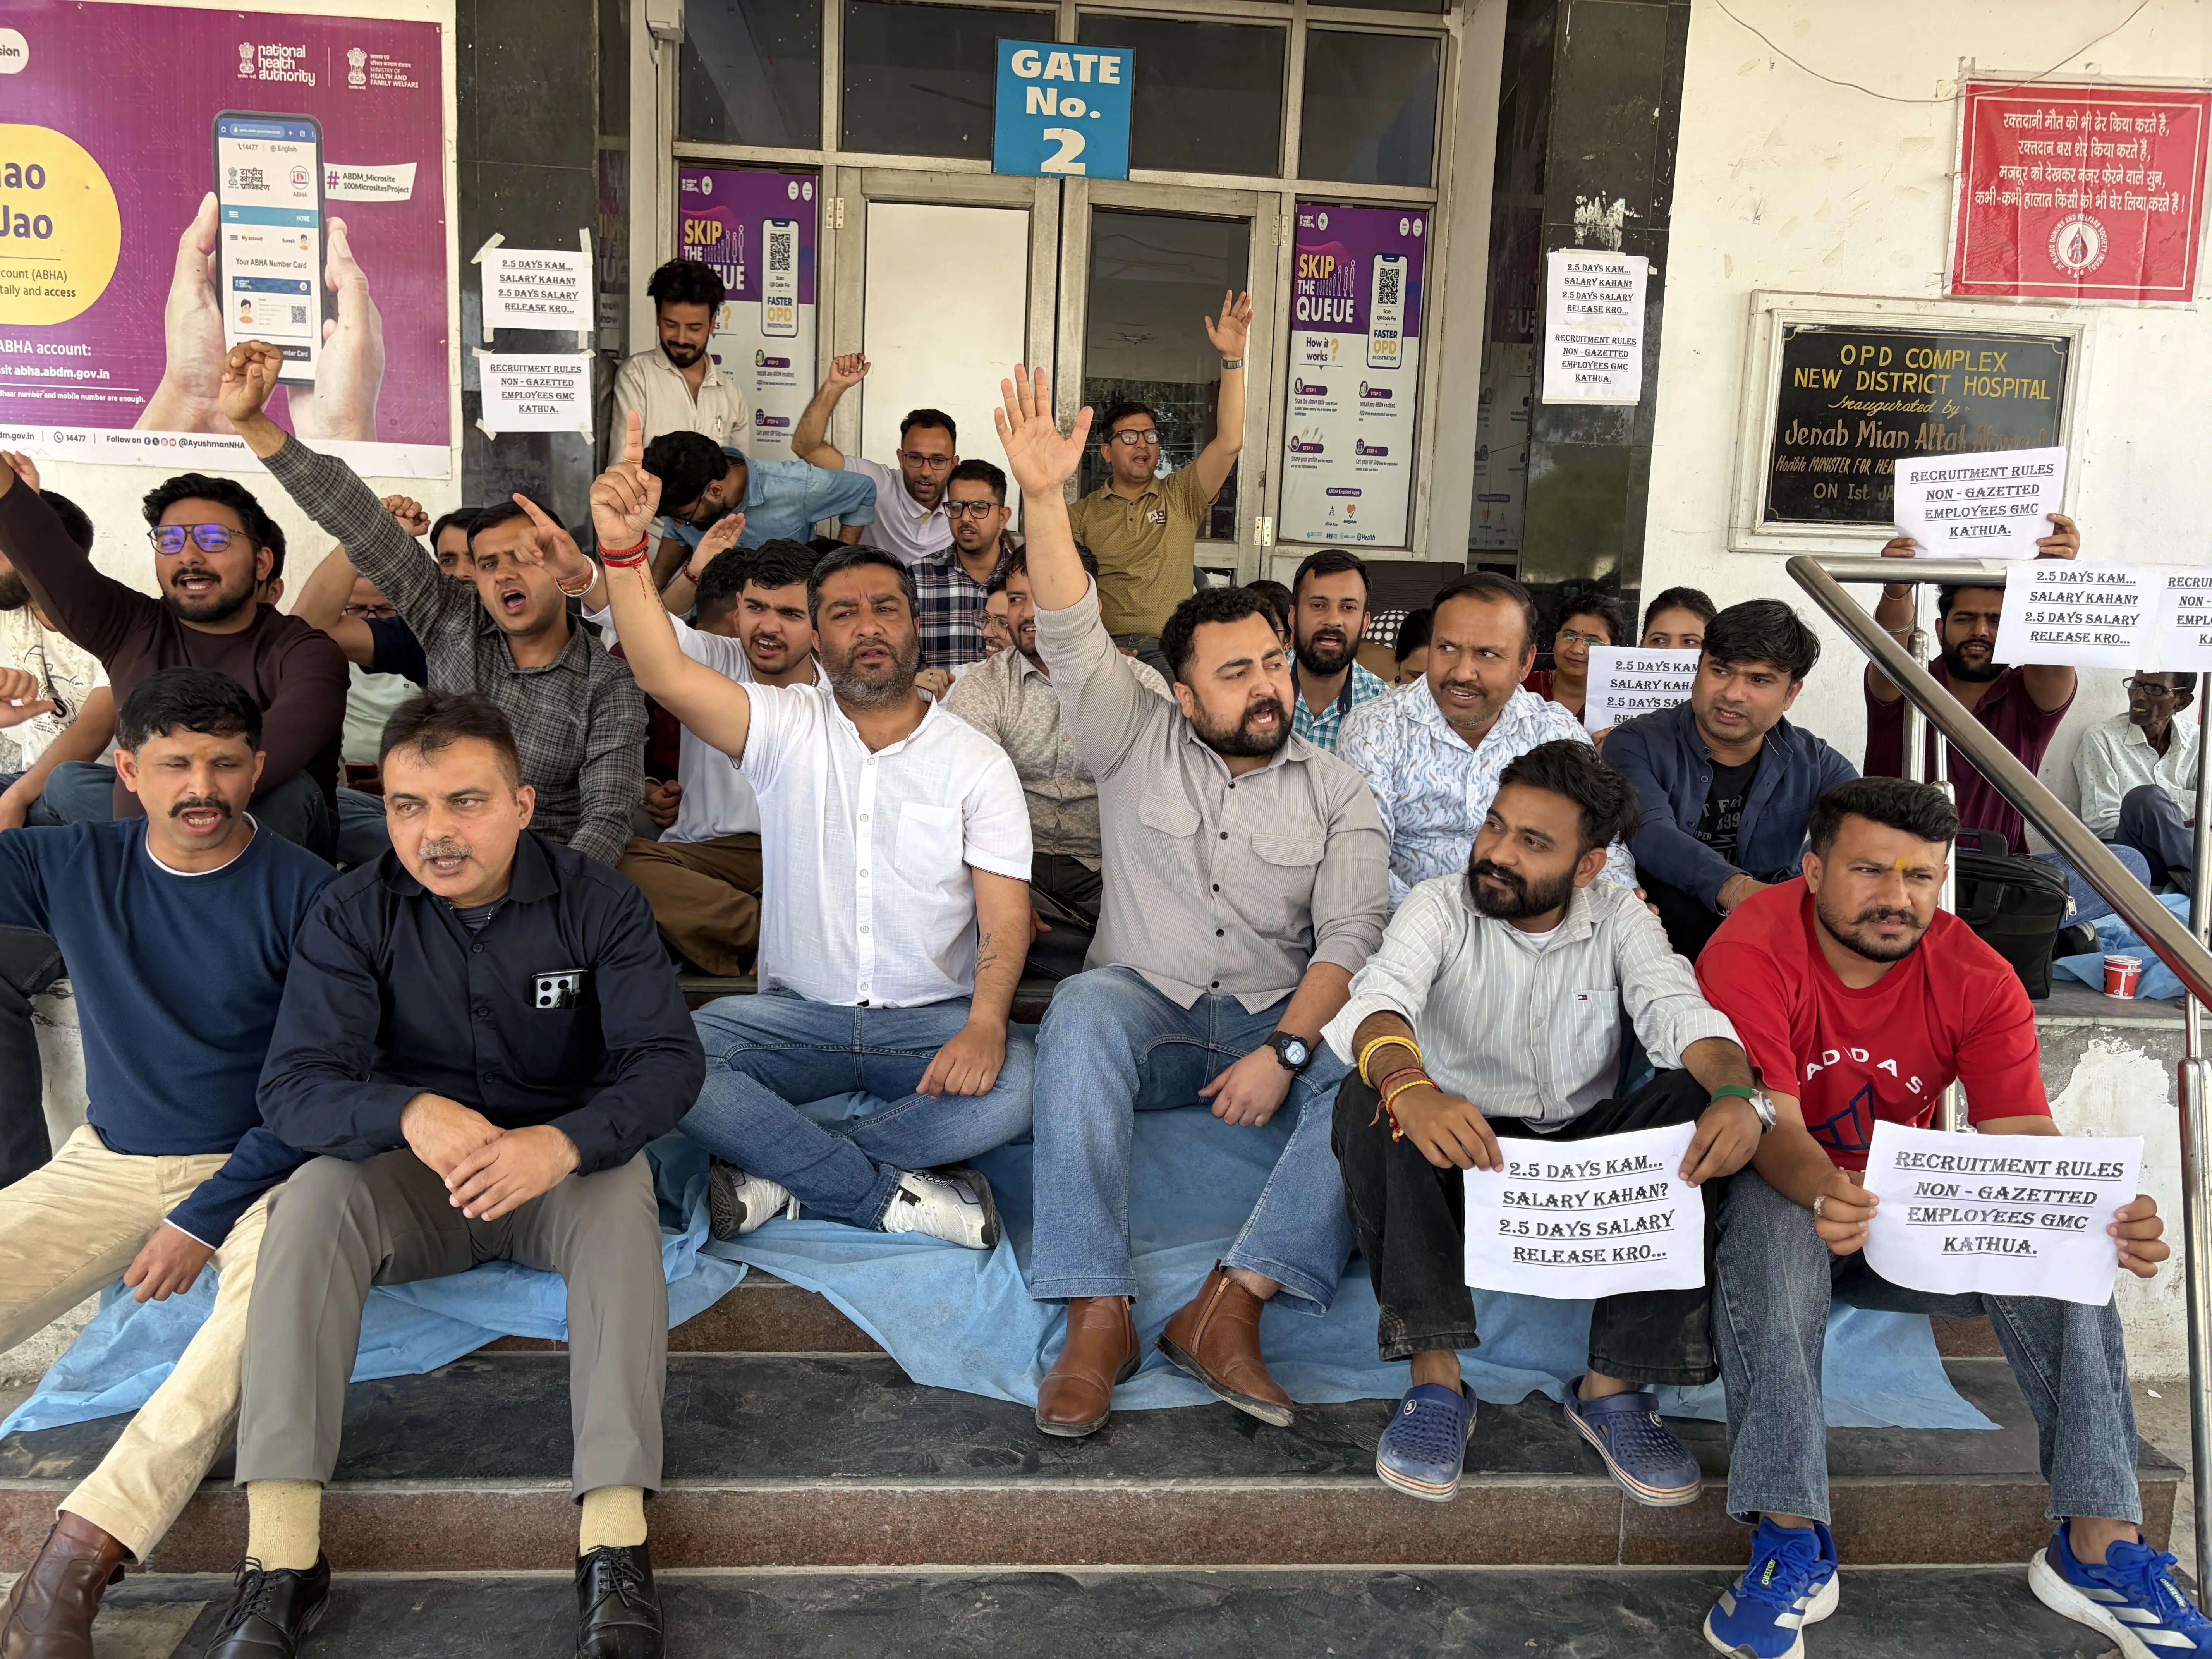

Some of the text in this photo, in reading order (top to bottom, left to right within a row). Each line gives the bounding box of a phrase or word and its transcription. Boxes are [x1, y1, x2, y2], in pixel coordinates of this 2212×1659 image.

[258, 44, 306, 58] national
[258, 57, 295, 69] health
[1011, 49, 1121, 84] GATE
[259, 69, 316, 87] authority
[1026, 86, 1101, 119] No.
[2003, 108, 2157, 133] रक्तदानी मौत को भी ढेर किया करते
[278, 145, 297, 153] English
[1041, 128, 1086, 175] 2
[2018, 136, 2138, 159] रक्तदान बस शेर किया करते
[343, 173, 395, 182] ABDM_Microsite
[1999, 161, 2144, 186] मजबूर को देखकर वाले
[344, 183, 409, 194] 100MicrositesProject
[2024, 188, 2170, 212] हालात किसी को भी घेर लिया करते
[0, 205, 53, 239] Jao
[2077, 213, 2101, 229] WELFARE
[684, 219, 722, 245] SKIP
[684, 246, 702, 261] THE
[269, 260, 292, 268] Number
[502, 260, 573, 271] 2.5 DAYS KAM...
[1299, 254, 1335, 279] SKIP
[32, 269, 67, 283] (ABHA)
[500, 275, 576, 285] SALARY KAHAN?
[1564, 278, 1598, 286] SALARY
[24, 286, 76, 297] and access
[498, 289, 579, 300] 2.5 DAYS SALARY
[1297, 280, 1315, 295] THE
[768, 297, 792, 306] FASTER
[1576, 292, 1598, 300] DAYS
[1600, 293, 1634, 301] SALARY
[505, 303, 575, 313] RELEASE KRO...
[768, 307, 792, 322] OPD
[1297, 296, 1354, 323] QUEUE
[1567, 304, 1628, 314] RELEASE KRO...
[1374, 330, 1398, 339] FASTER
[0, 340, 91, 356] ABHA account:
[1306, 337, 1329, 348] How it
[1373, 341, 1397, 355] OPD
[1307, 350, 1328, 361] works
[1840, 344, 2008, 373] OPD COMPLEX
[14, 365, 110, 380] abha.abdm.gov.in
[490, 364, 582, 374] RECRUITMENT RULES
[526, 378, 574, 387] GAZETTED
[1794, 368, 2050, 400] NEW DISTRICT HOSPITAL
[18, 391, 42, 399] number
[119, 396, 146, 404] enough.
[501, 391, 575, 400] EMPLOYEES GMC
[519, 405, 559, 413] KATHUA.
[1828, 395, 1960, 420] Inaugurated by
[106, 435, 131, 444] Follow
[179, 438, 246, 449] @AyushmanNHA
[1785, 419, 1966, 452] Jenab Mian Altaf
[1808, 457, 1871, 475] MINISTER FOR
[1910, 464, 2054, 483] RECRUITMENT RULES
[1814, 483, 1838, 499] ON
[1926, 484, 2040, 500] NON GAZETTED
[1925, 503, 2039, 520] EMPLOYEES GMC
[1949, 525, 2011, 538] KATHUA.
[2037, 571, 2136, 585] 2.5 DAYS KAM...
[2030, 591, 2138, 605] SALARY KAHAN?
[2025, 612, 2140, 626] 2.5 DAYS SALARY
[2030, 631, 2130, 645] RELEASE KRO...
[1615, 661, 1670, 672] 2.5 DAYS
[1611, 679, 1662, 690] SALARY
[1607, 697, 1661, 708] 2.5 DAYS
[1510, 1162, 1540, 1178] 2.5
[1547, 1160, 1601, 1178] DAYS
[1895, 1152, 2123, 1178] RECRUITMENT RULES
[1503, 1190, 1590, 1209] SALARY
[1914, 1182, 2097, 1205] NON GAZETTED
[1499, 1209, 1675, 1237] 2.5 DAYS SALARY
[1908, 1207, 2090, 1230] EMPLOYEES GMC
[1943, 1236, 2037, 1255] KATHUA.
[1513, 1247, 1606, 1264] RELEASE
[1762, 1559, 1776, 1585] ADIZERO
